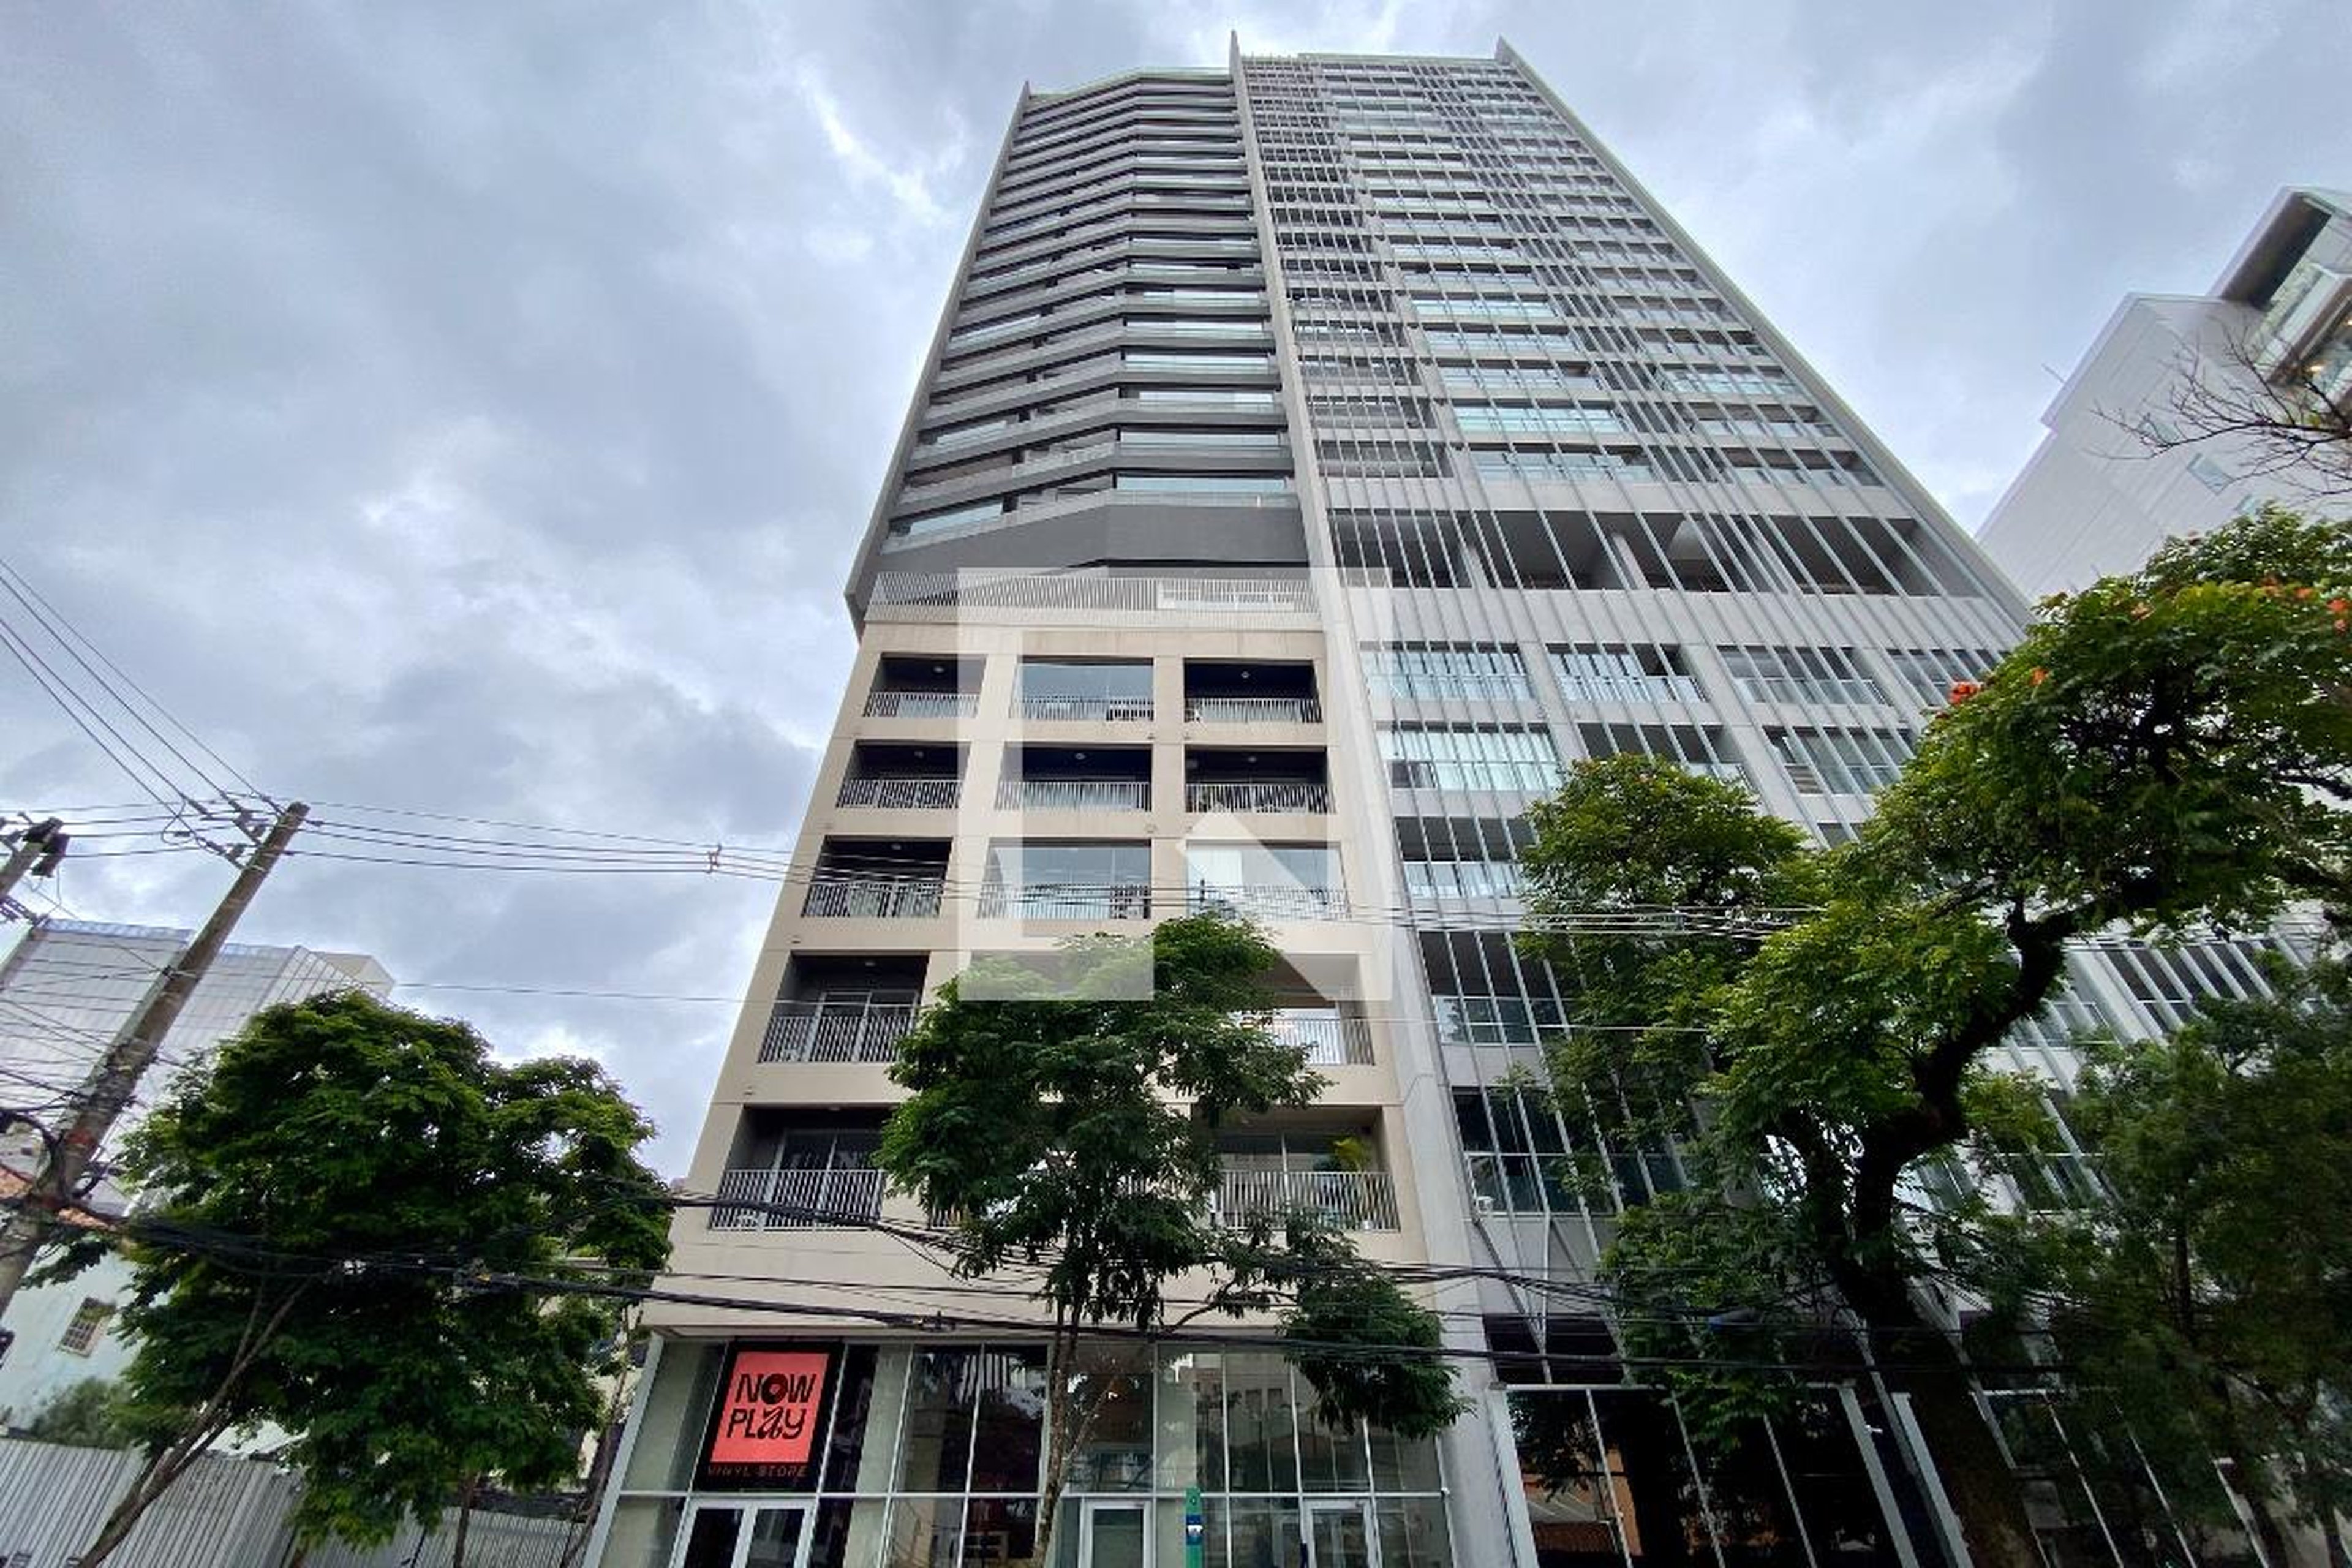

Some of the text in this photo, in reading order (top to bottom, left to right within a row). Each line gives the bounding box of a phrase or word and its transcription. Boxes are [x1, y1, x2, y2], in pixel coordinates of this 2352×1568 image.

[735, 1373, 816, 1404] NOW
[708, 1465, 809, 1477] VINYL STORE
